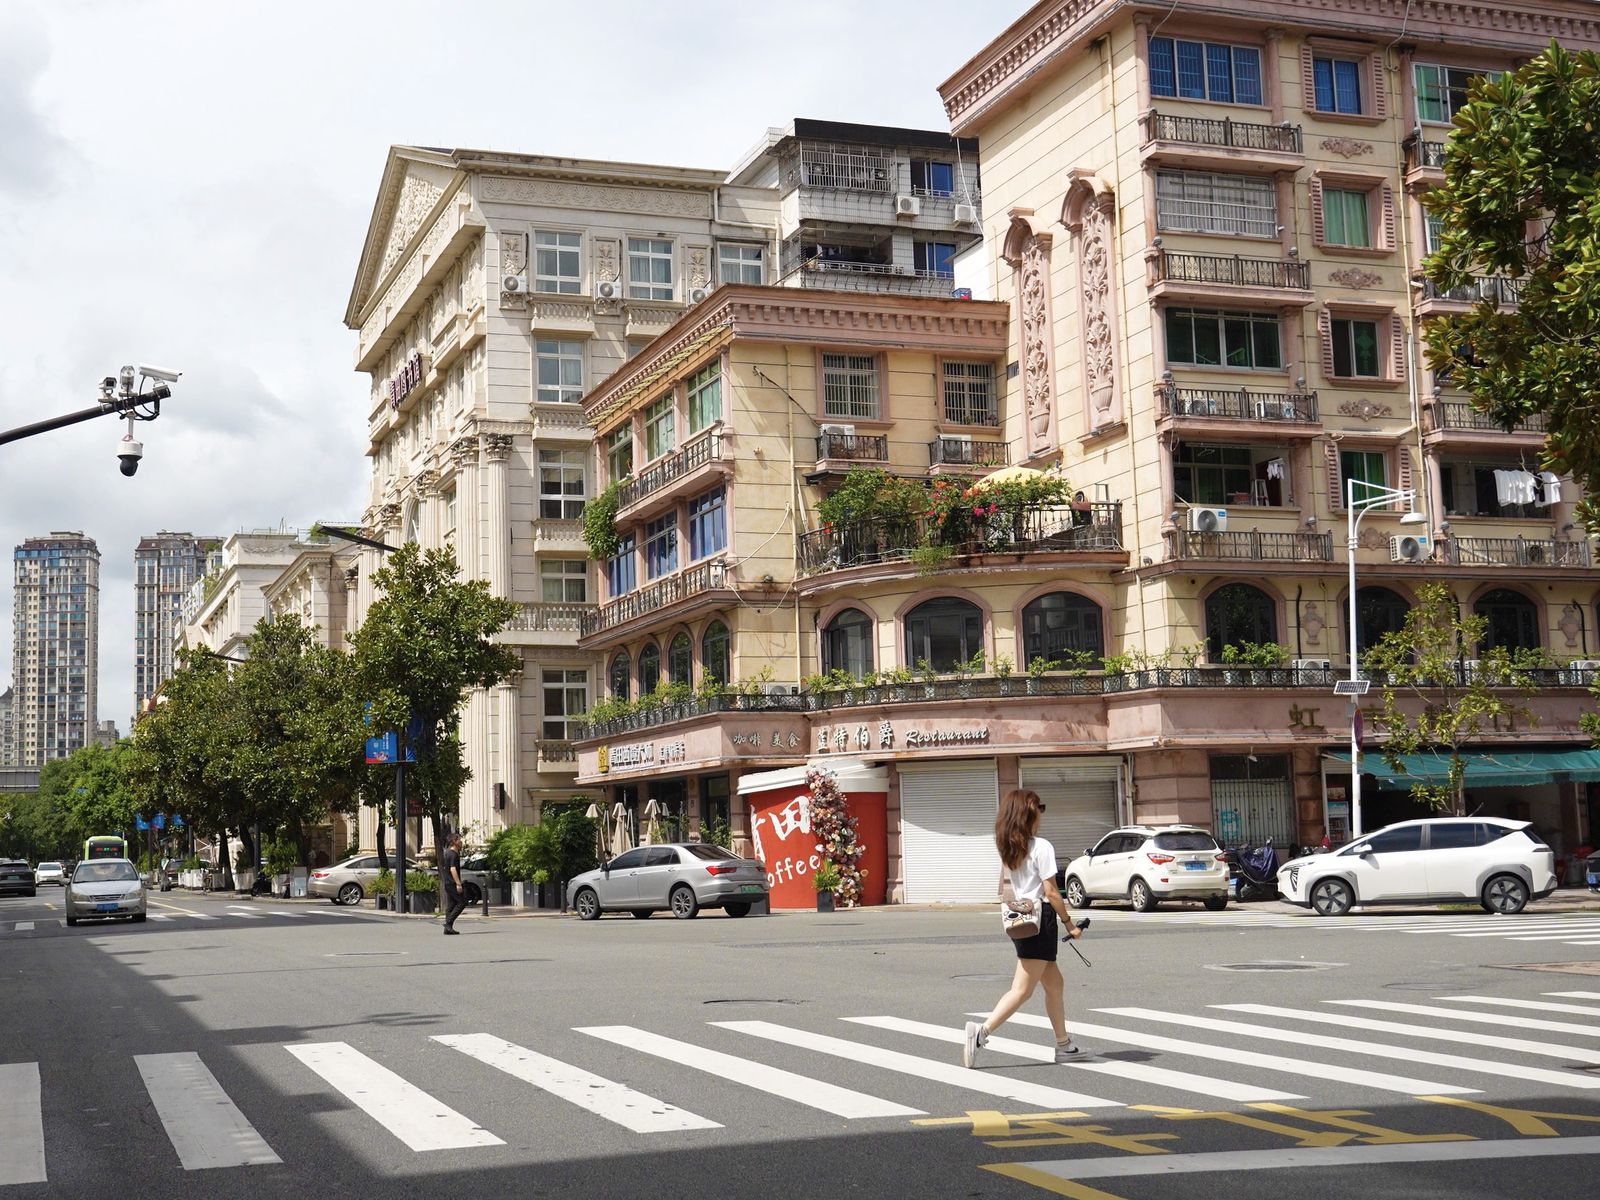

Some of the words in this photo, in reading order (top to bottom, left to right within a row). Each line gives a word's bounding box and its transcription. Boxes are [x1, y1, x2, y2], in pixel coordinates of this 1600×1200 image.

[733, 732, 761, 747] 咖啡
[770, 730, 801, 748] 美食
[905, 727, 989, 745] Restaurant
[767, 855, 821, 888] offee
